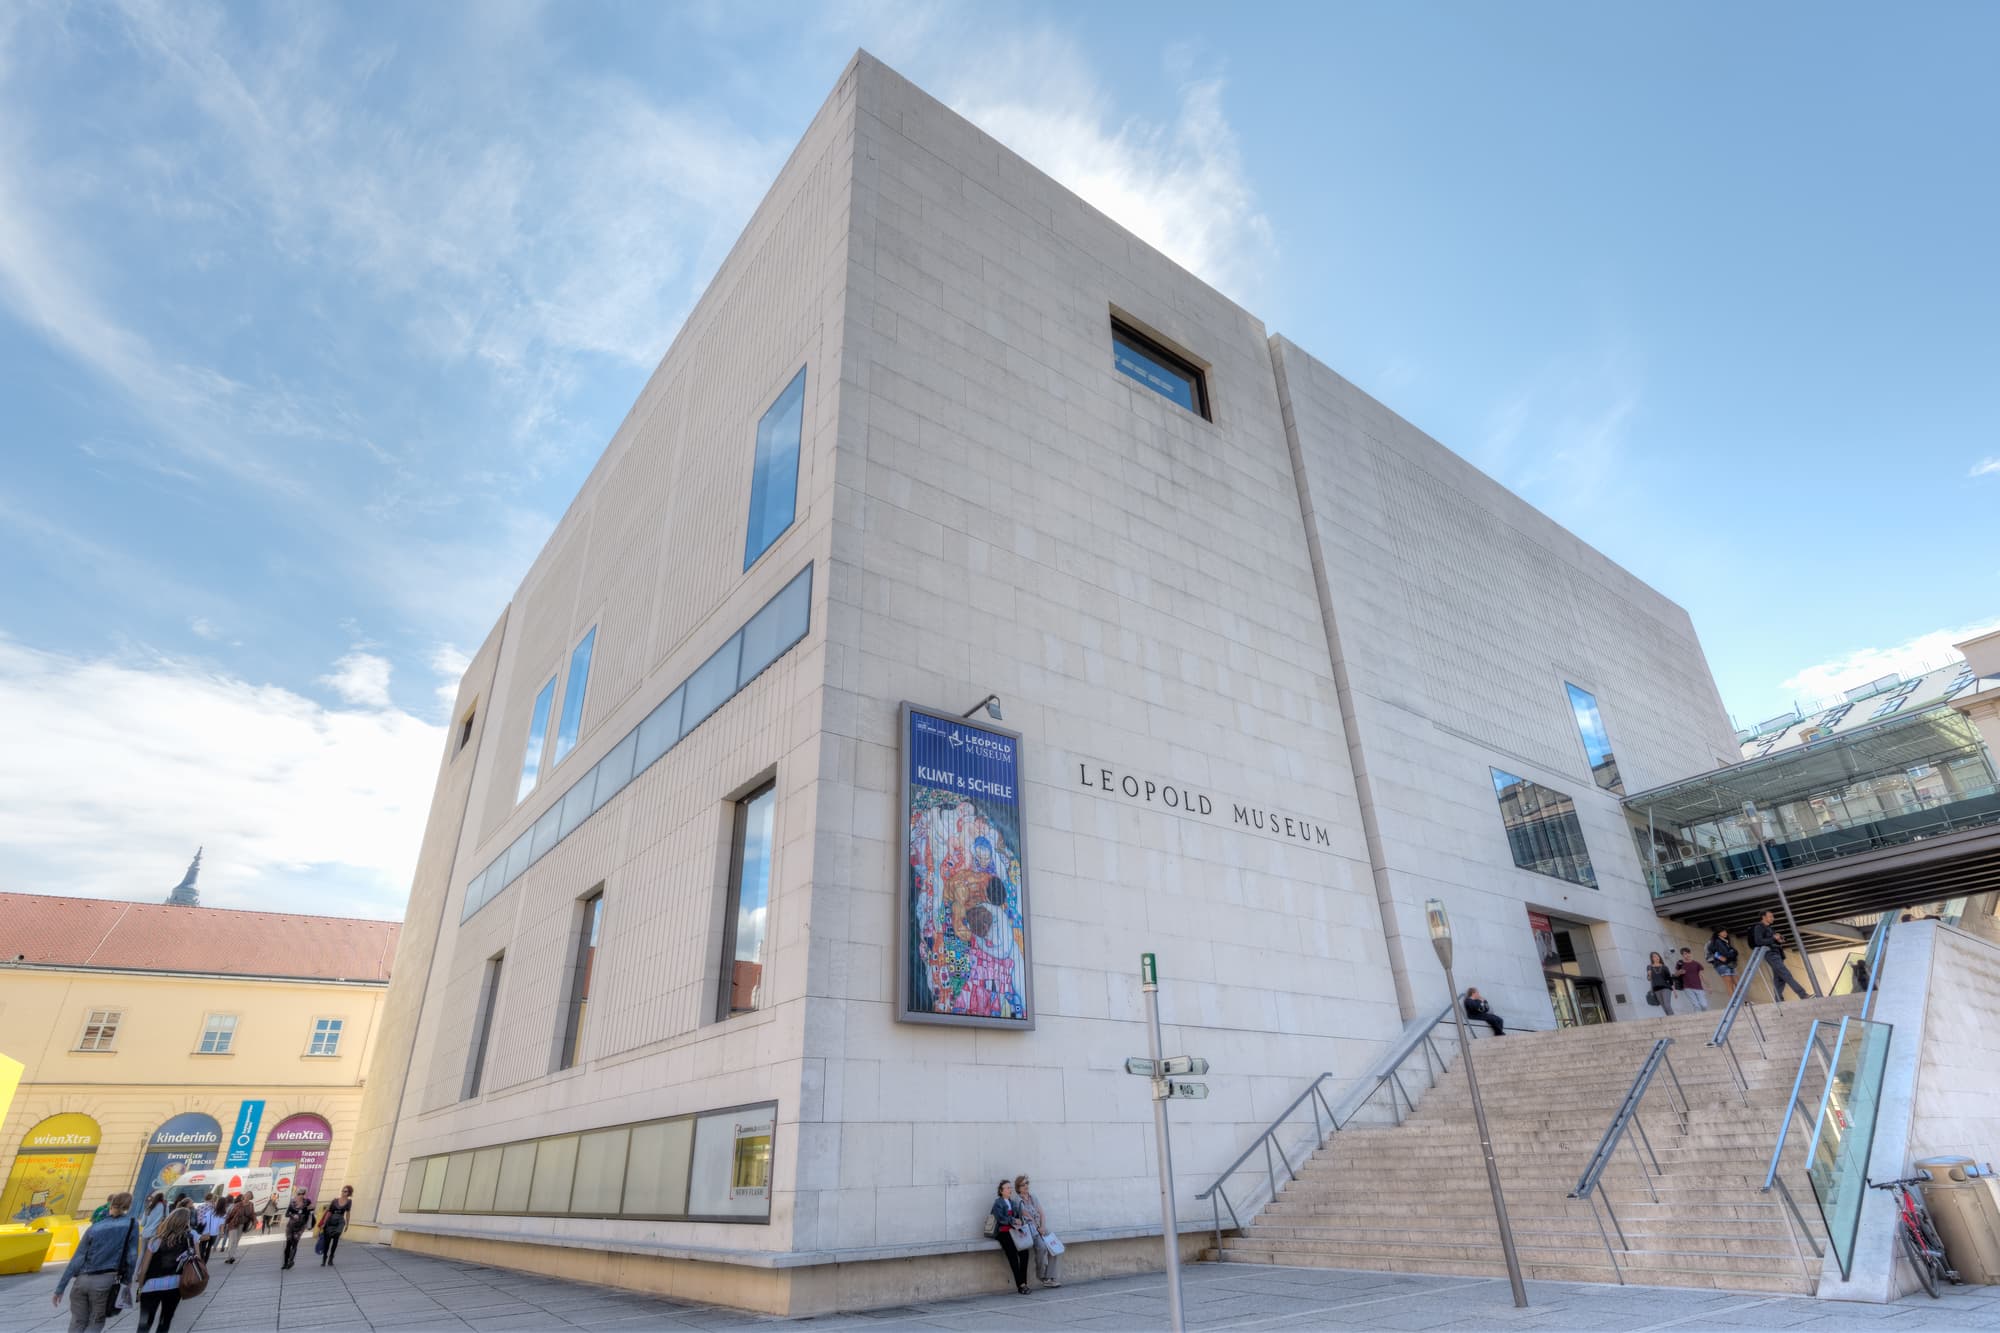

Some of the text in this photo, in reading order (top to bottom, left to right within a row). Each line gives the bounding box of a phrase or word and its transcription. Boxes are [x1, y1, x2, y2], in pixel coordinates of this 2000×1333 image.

[965, 735, 1011, 753] LEOPOLD
[966, 745, 1011, 763] MUSEUM
[917, 765, 1012, 798] KLIMT & SCHIELE
[1079, 763, 1331, 846] LEOPOLD MUSEUM
[33, 1133, 92, 1145] wienXtra
[156, 1131, 217, 1144] kinderinfo
[276, 1130, 324, 1140] wienXtra
